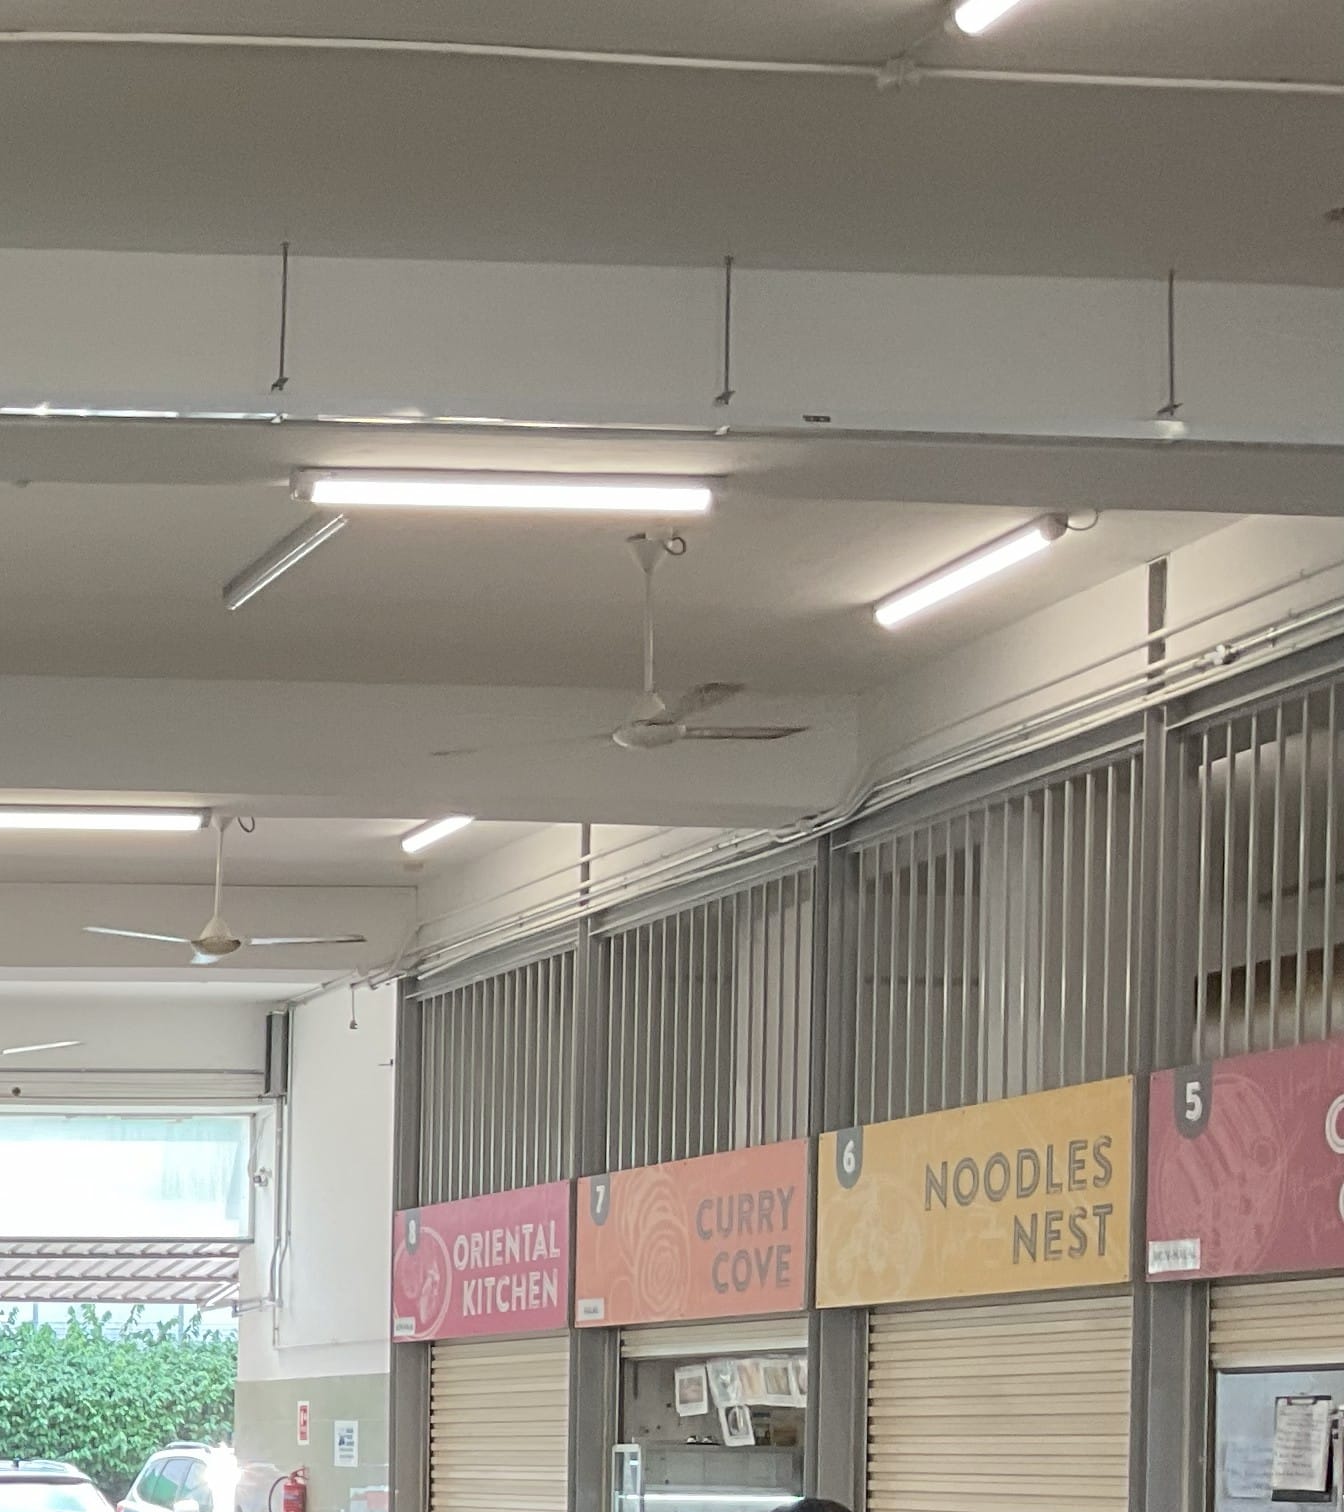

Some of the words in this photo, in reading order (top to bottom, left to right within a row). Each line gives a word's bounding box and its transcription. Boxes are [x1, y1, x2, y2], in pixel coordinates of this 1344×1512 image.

[1185, 1081, 1203, 1121] 5
[842, 1140, 855, 1174] 6
[924, 1135, 1113, 1211] NOODLES
[595, 1184, 606, 1214] 7
[696, 1186, 795, 1240] CURRY
[408, 1219, 417, 1245] 8
[453, 1219, 561, 1270] ORIENTAL
[1012, 1203, 1113, 1264] NEST
[463, 1268, 559, 1316] KITCHEN
[713, 1245, 792, 1294] COVE
